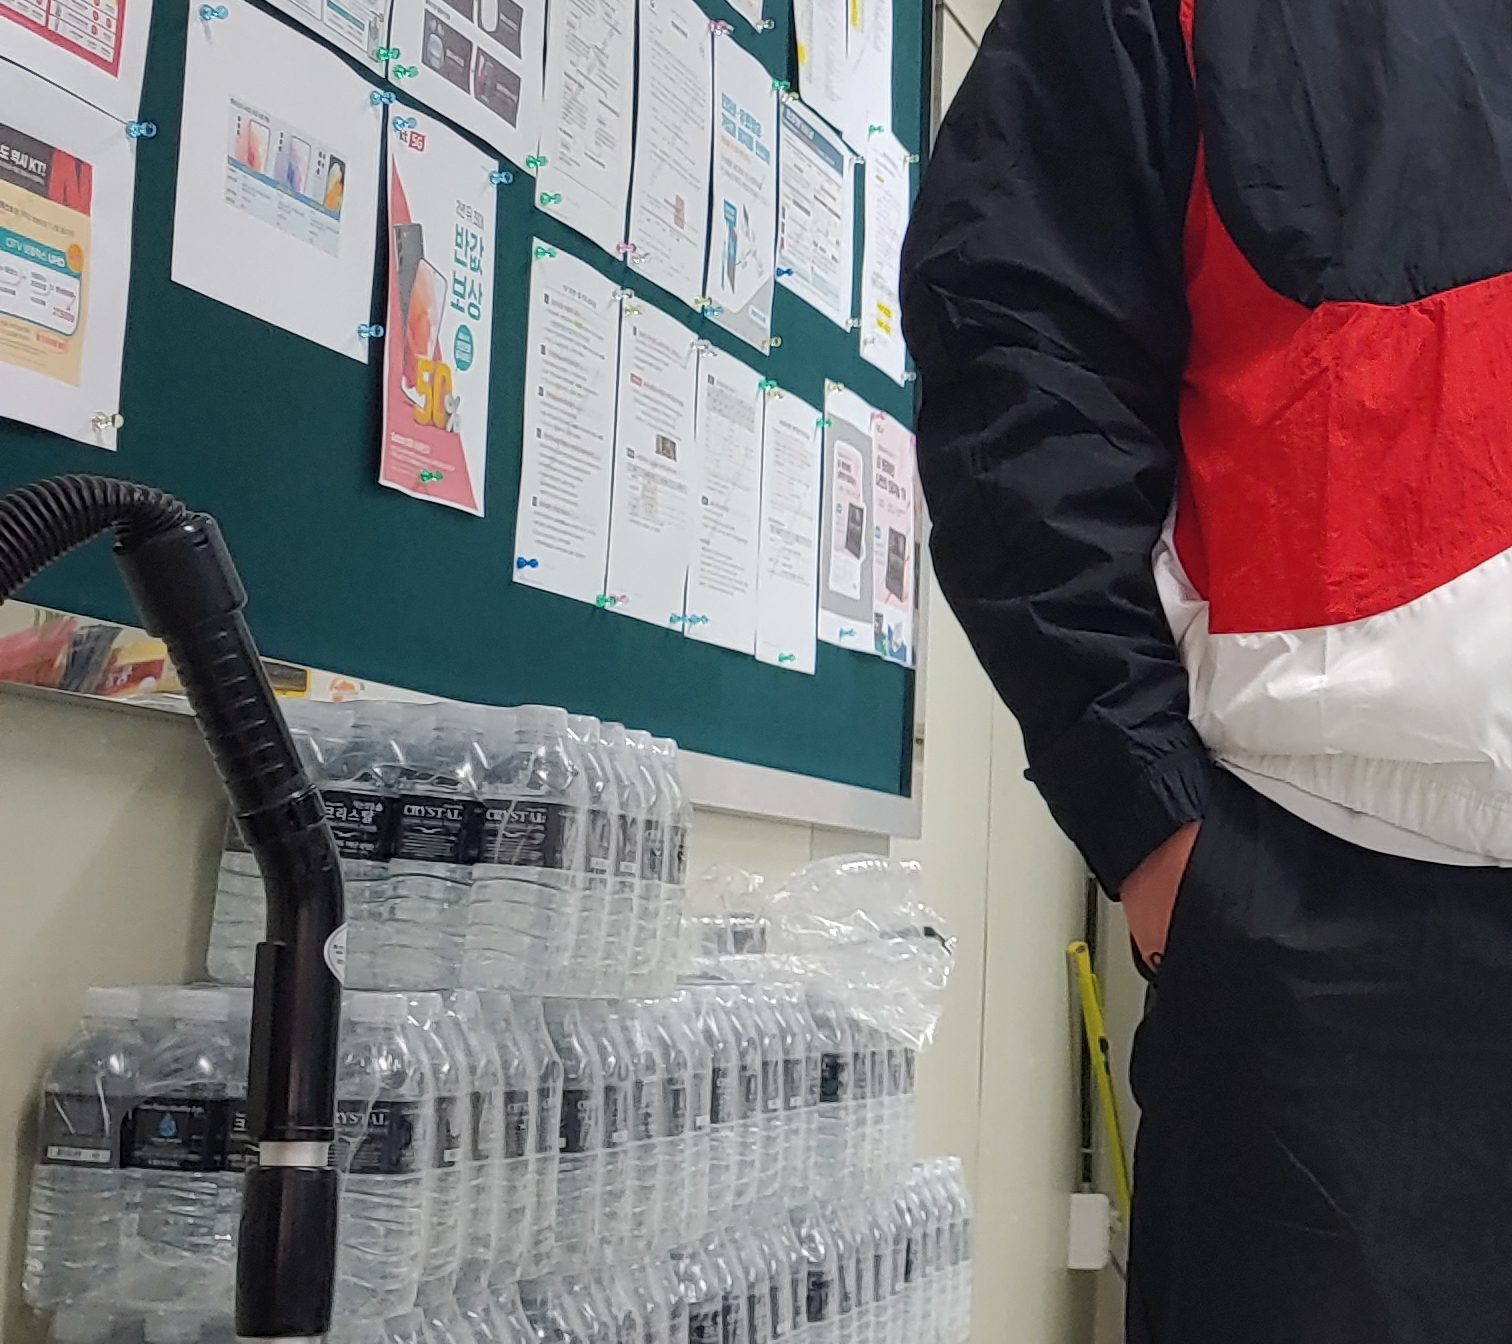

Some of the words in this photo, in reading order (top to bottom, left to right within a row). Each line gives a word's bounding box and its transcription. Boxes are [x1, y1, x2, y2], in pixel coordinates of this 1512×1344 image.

[410, 133, 425, 151] 5G
[28, 156, 47, 177] KT!
[454, 223, 485, 277] 반값
[450, 268, 485, 322] 보상
[413, 356, 462, 434] 50%
[403, 804, 463, 821] CRYSTAL
[485, 808, 547, 824] CRYSTAL
[335, 1110, 389, 1126] RYSTAL
